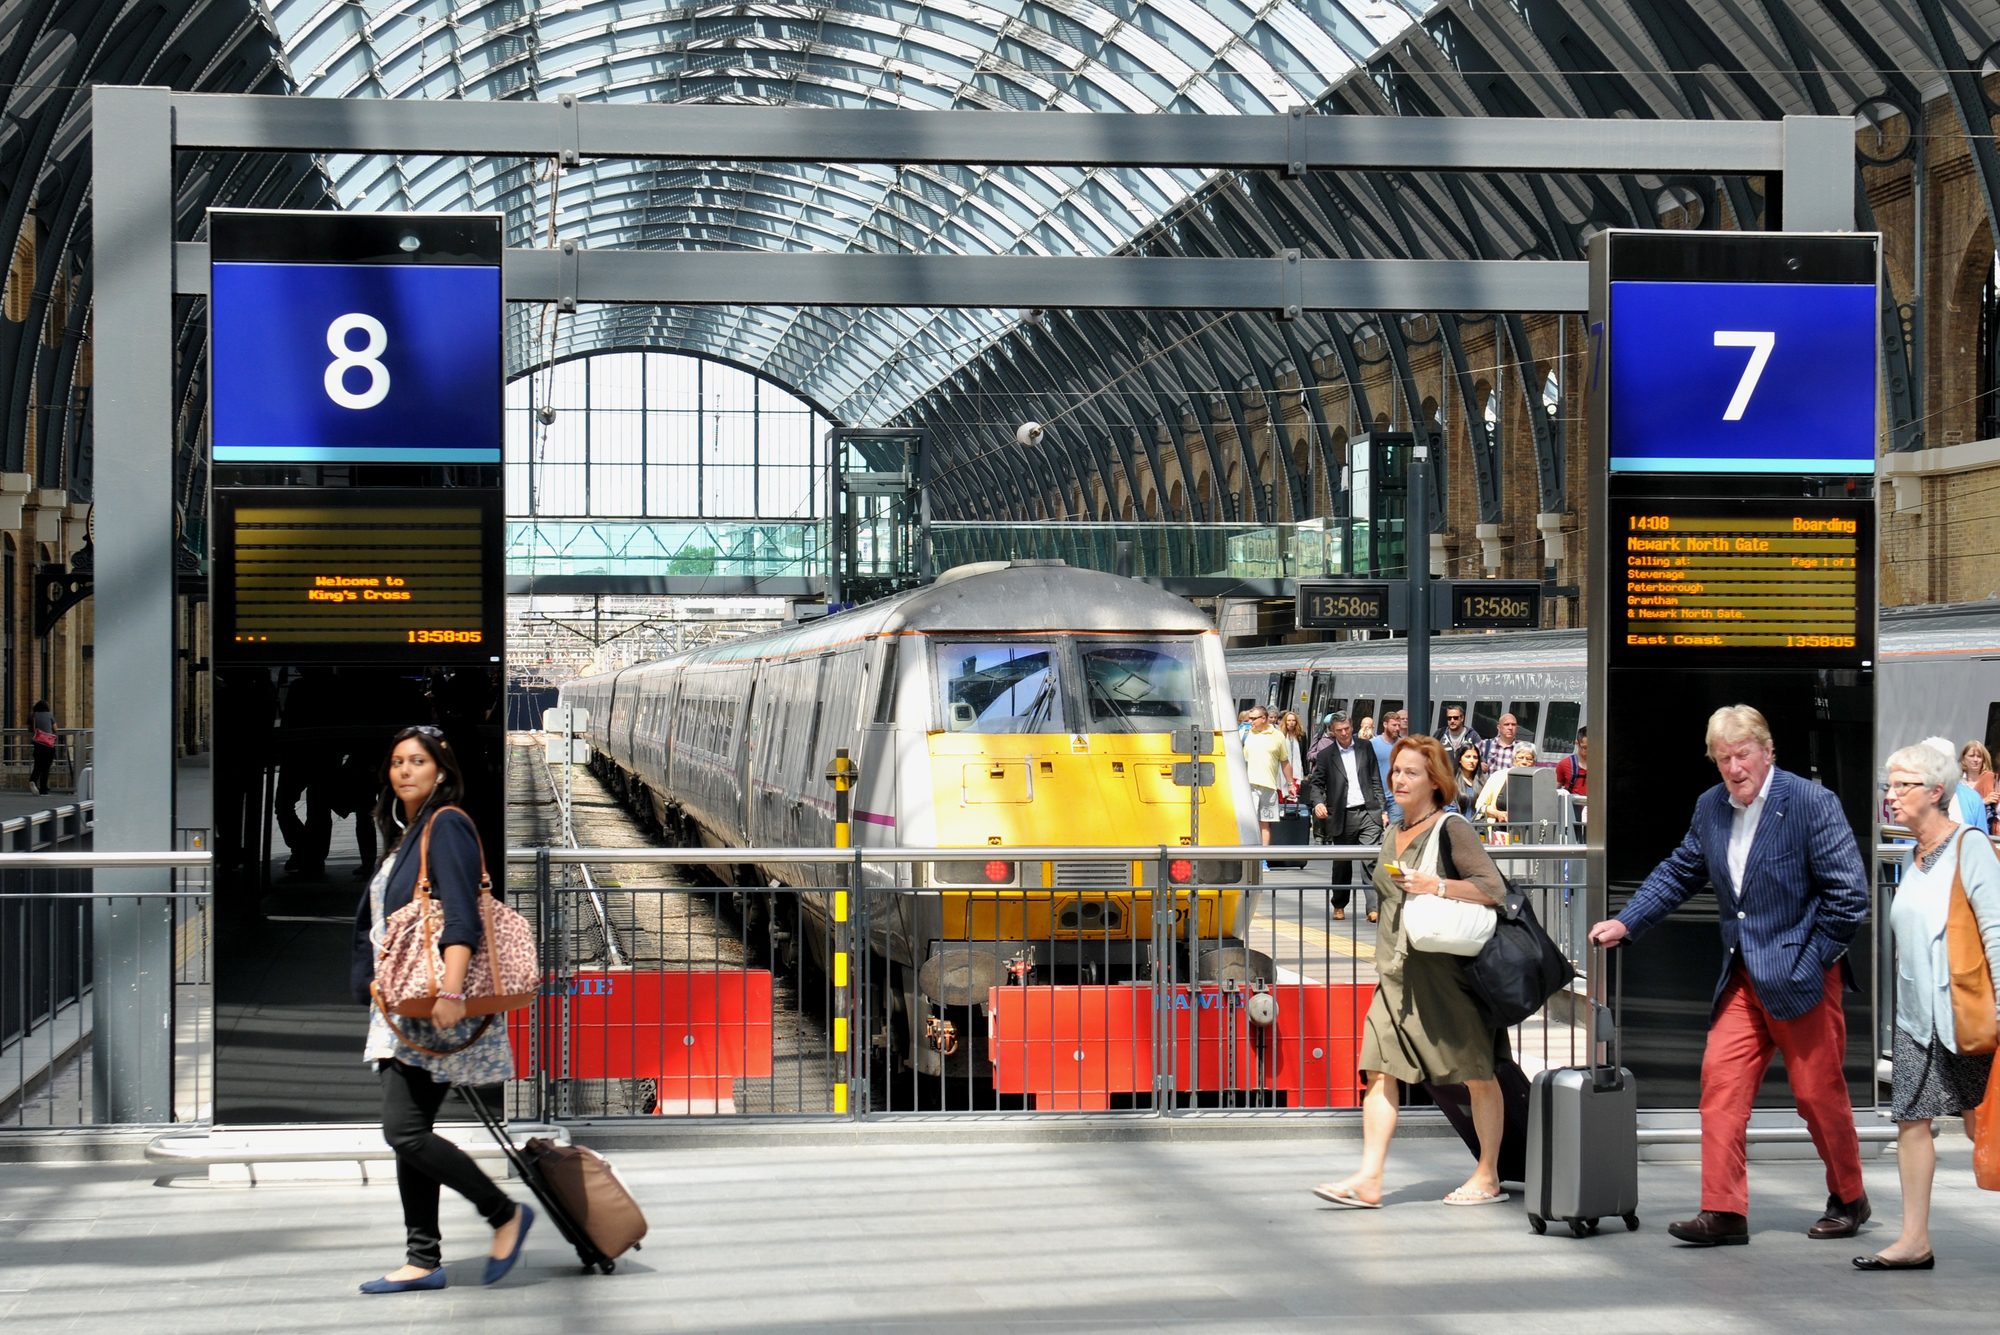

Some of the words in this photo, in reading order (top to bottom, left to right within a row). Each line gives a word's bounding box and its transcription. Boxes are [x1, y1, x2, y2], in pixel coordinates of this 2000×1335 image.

[324, 312, 391, 410] 8
[1713, 330, 1776, 421] 7
[1629, 516, 1670, 531] 14:08
[1792, 517, 1857, 534] Boarding
[1627, 537, 1681, 552] Newark
[1686, 537, 1730, 552] North
[1735, 537, 1769, 552] Gate
[1627, 556, 1671, 569] Calling
[1675, 556, 1691, 568] at:
[1791, 557, 1819, 570] Page
[1832, 557, 1845, 568] of
[1849, 557, 1856, 567] 1
[315, 576, 380, 587] Welcome
[385, 576, 405, 587] to
[1627, 569, 1685, 581] Stevenage
[1627, 582, 1704, 594] Peterborough
[308, 589, 358, 602] King's
[363, 589, 411, 601] Cross
[1627, 595, 1679, 606] Grantham
[1627, 608, 1635, 618] &
[1639, 608, 1677, 619] Newark
[1681, 608, 1713, 619] North
[1717, 608, 1745, 619] Gate.
[407, 630, 482, 643] 13:58:05
[1627, 634, 1667, 645] East
[1673, 634, 1723, 645] Coast
[1786, 635, 1856, 648] 13:58:05
